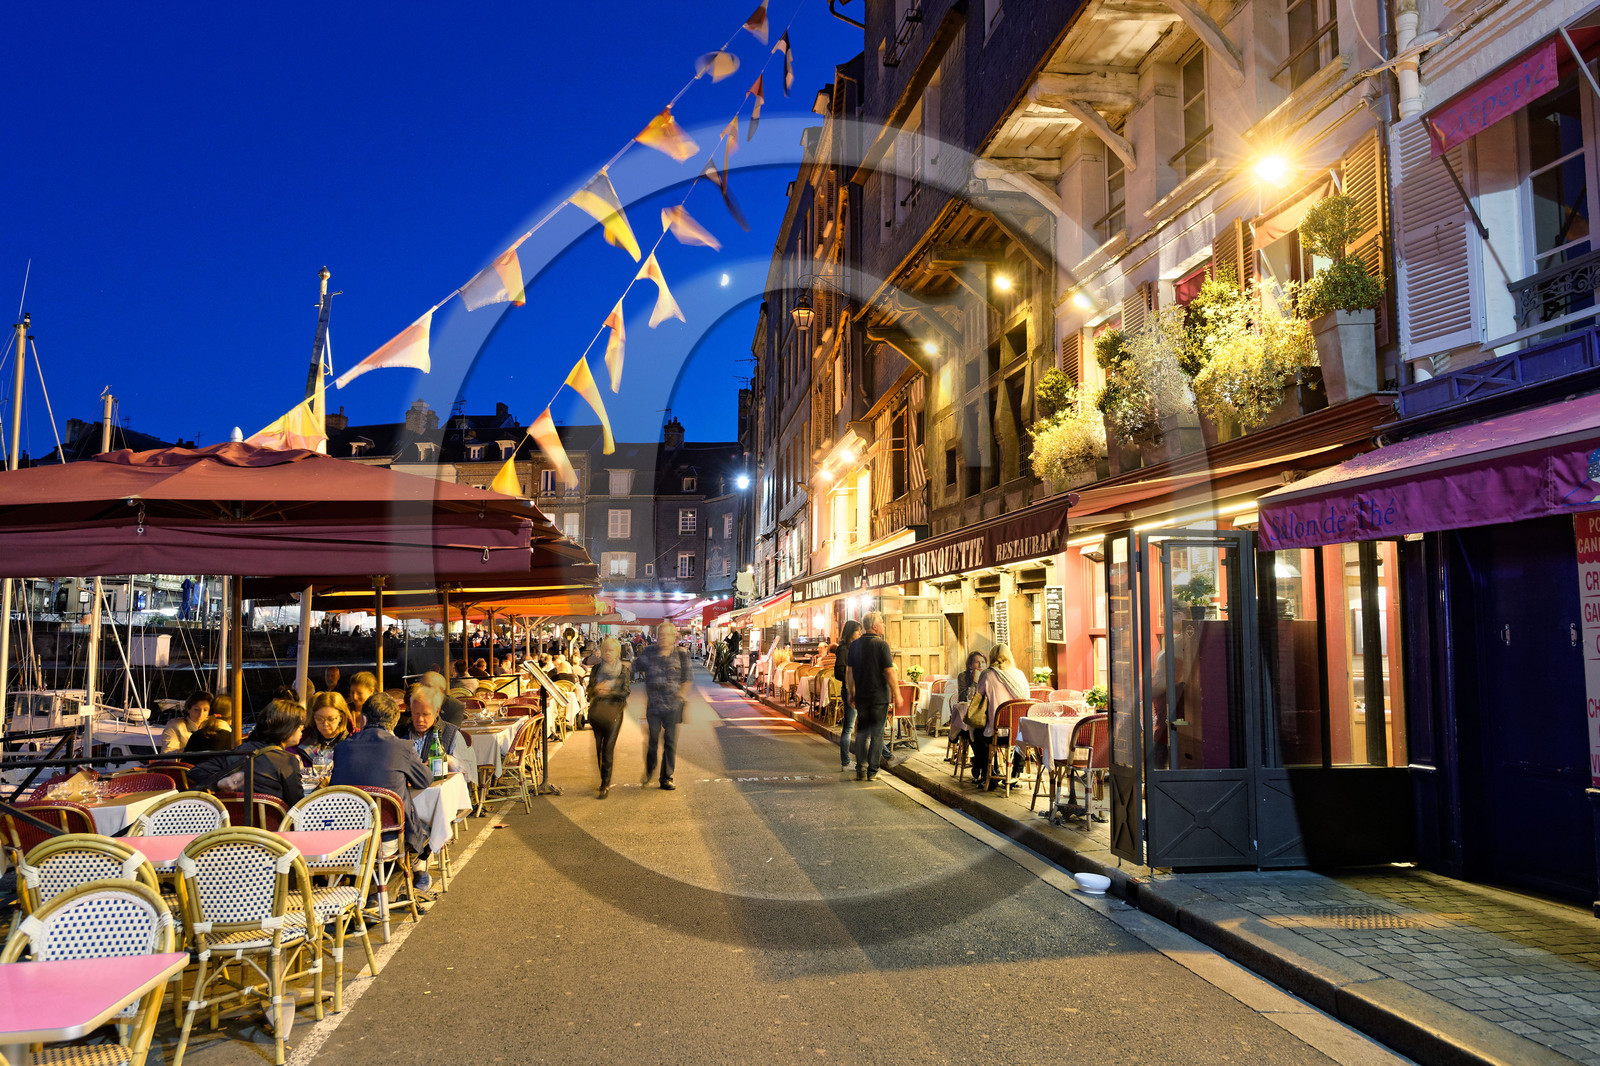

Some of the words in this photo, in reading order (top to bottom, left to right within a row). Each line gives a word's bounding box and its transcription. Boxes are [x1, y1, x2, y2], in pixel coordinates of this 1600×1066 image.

[1436, 62, 1545, 139] Crêperie
[1270, 513, 1317, 541] Salon
[1323, 506, 1347, 534] de
[1352, 498, 1395, 529] Thé
[900, 556, 911, 581] LA
[913, 536, 985, 579] TRINQUETTE
[995, 528, 1061, 562] RESTAURANT
[1577, 536, 1600, 554] CAN
[1585, 571, 1600, 591] CR
[1584, 602, 1600, 623] GA
